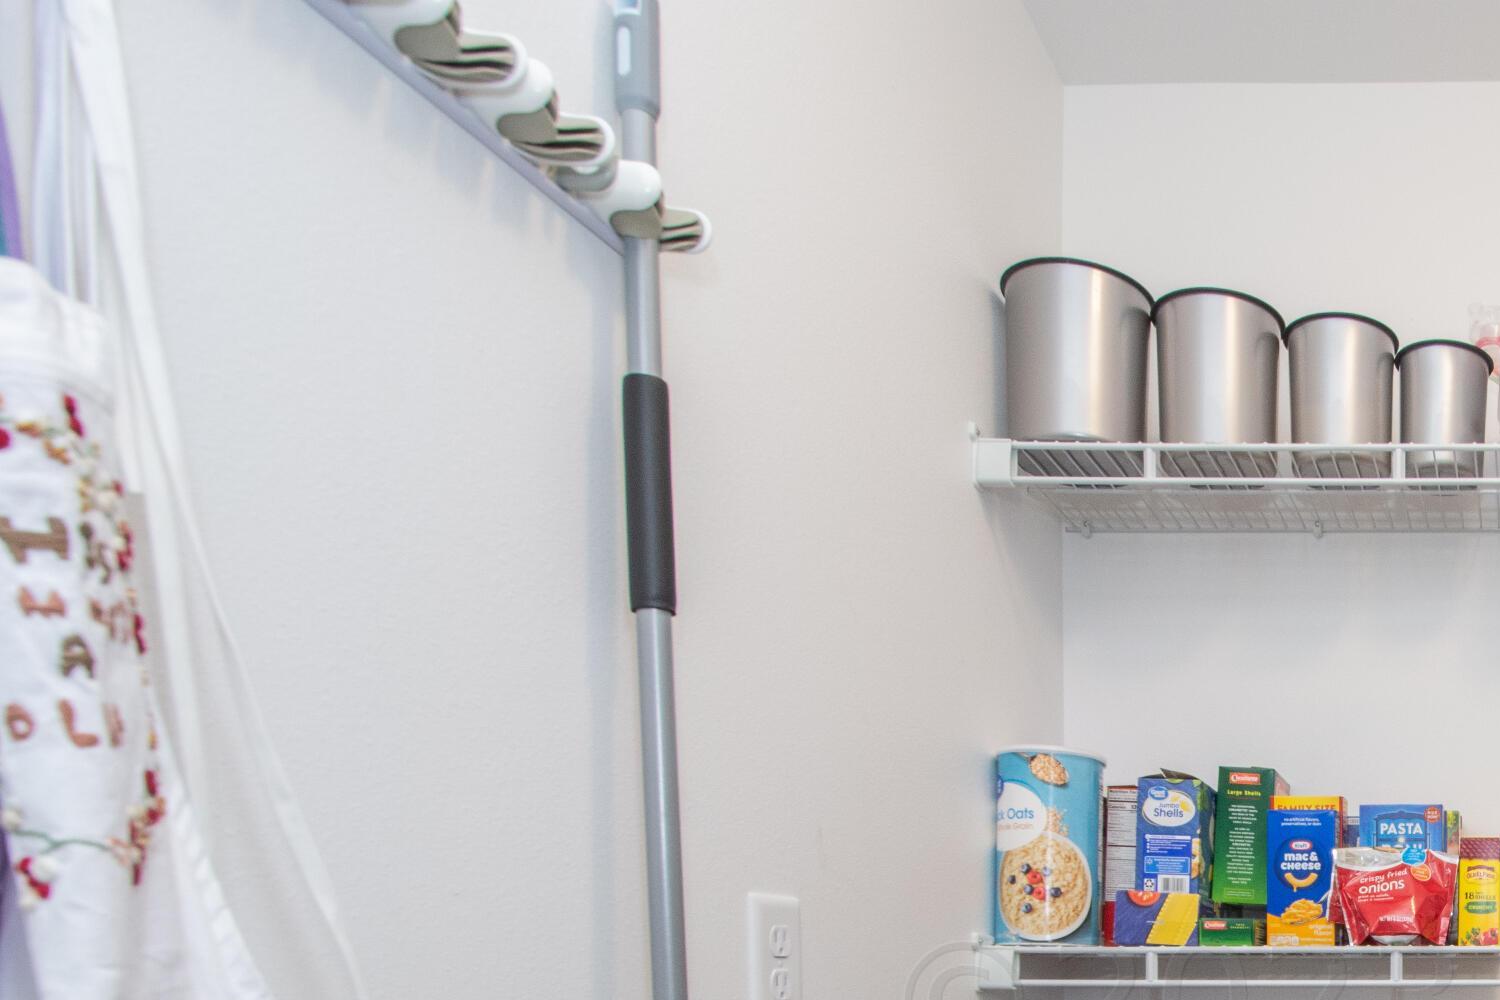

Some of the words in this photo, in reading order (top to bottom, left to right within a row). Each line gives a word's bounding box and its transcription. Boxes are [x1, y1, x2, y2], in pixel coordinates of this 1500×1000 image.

[1227, 789, 1243, 797] Large
[1006, 807, 1034, 819] Oats
[1153, 806, 1184, 818] Shells
[1380, 822, 1423, 835] PASTA
[1284, 853, 1308, 862] mac
[1310, 851, 1319, 862] &
[1360, 875, 1385, 884] crispy
[1387, 868, 1408, 878] fried
[1358, 879, 1405, 895] onions
[1464, 891, 1475, 900] 18
